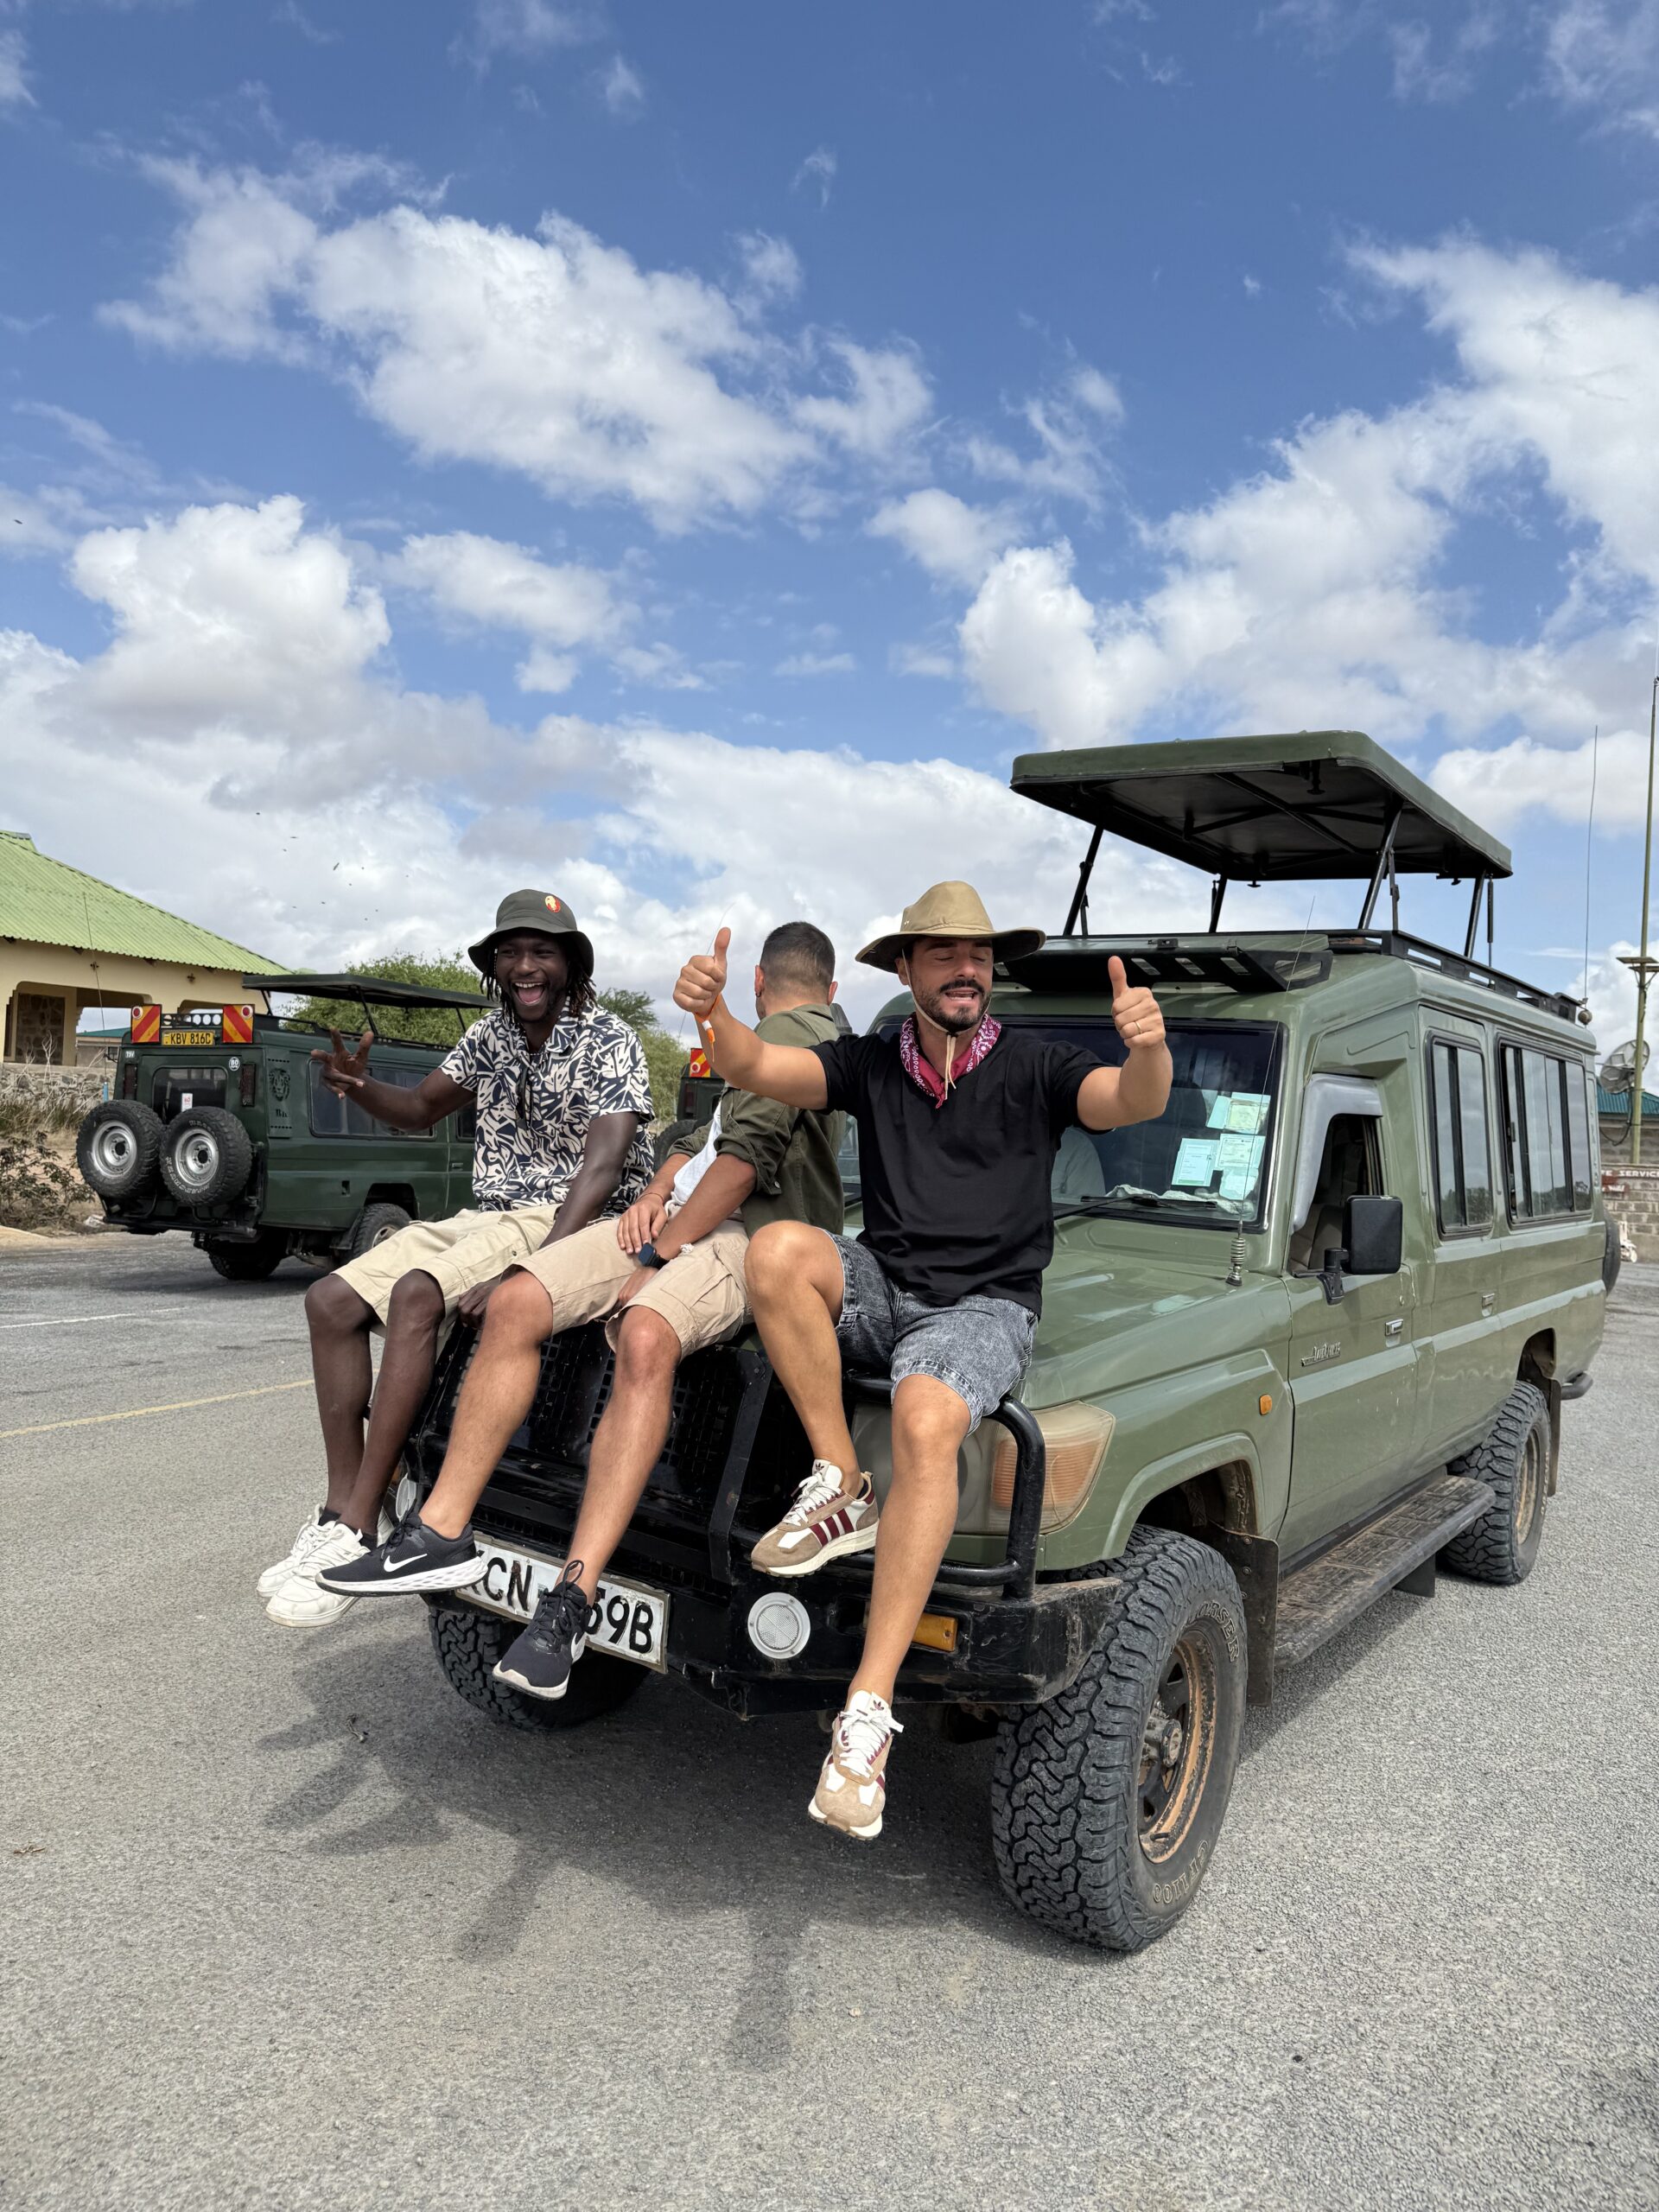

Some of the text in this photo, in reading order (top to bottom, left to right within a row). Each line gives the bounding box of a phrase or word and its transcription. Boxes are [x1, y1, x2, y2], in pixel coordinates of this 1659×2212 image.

[170, 1033, 211, 1044] KBV 816C
[461, 1549, 533, 1612] CN
